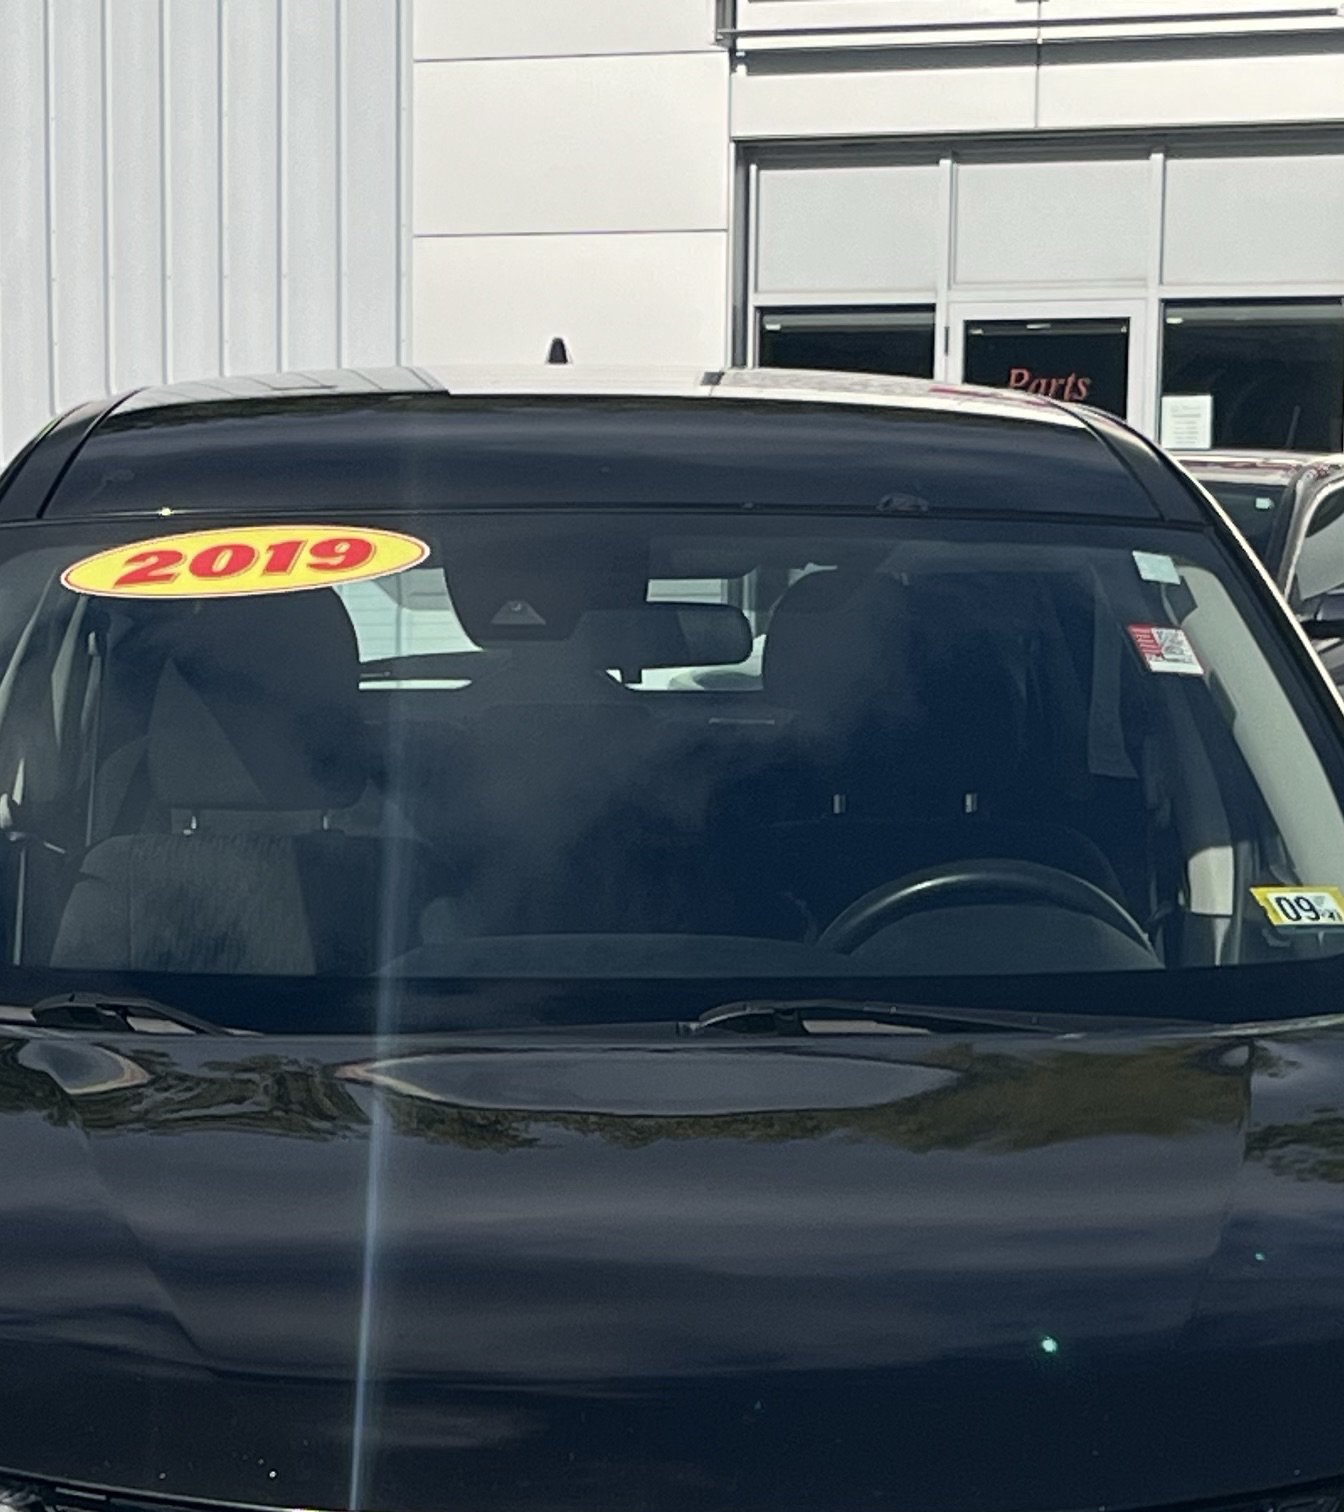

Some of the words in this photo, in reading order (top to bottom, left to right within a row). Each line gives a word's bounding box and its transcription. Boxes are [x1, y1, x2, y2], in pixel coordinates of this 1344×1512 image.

[1007, 367, 1092, 401] Parts
[113, 537, 377, 589] 2019
[1274, 896, 1321, 922] 09
